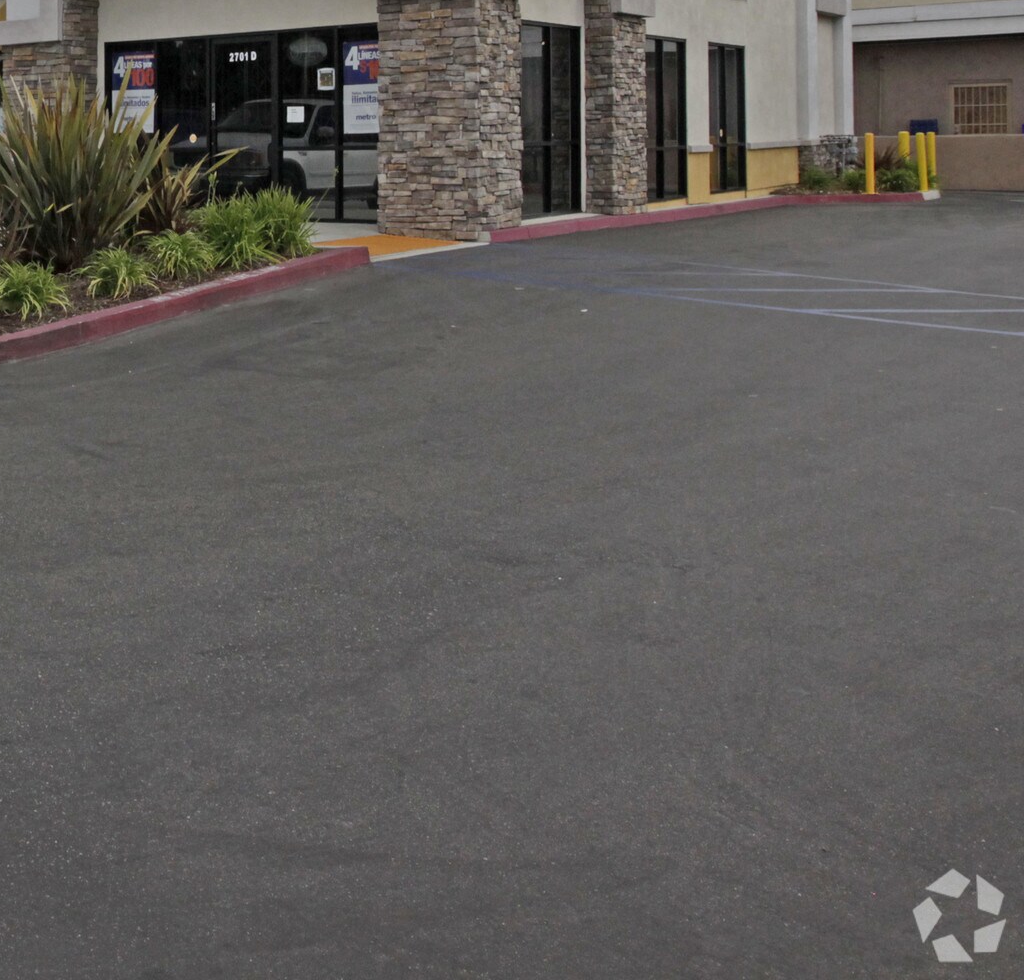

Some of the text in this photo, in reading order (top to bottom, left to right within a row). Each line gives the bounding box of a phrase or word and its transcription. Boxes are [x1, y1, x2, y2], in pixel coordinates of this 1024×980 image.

[229, 51, 257, 62] 2701 D
[344, 46, 359, 70] 4
[113, 55, 125, 77] 4
[130, 68, 155, 86] 100
[351, 95, 378, 104] ilimita
